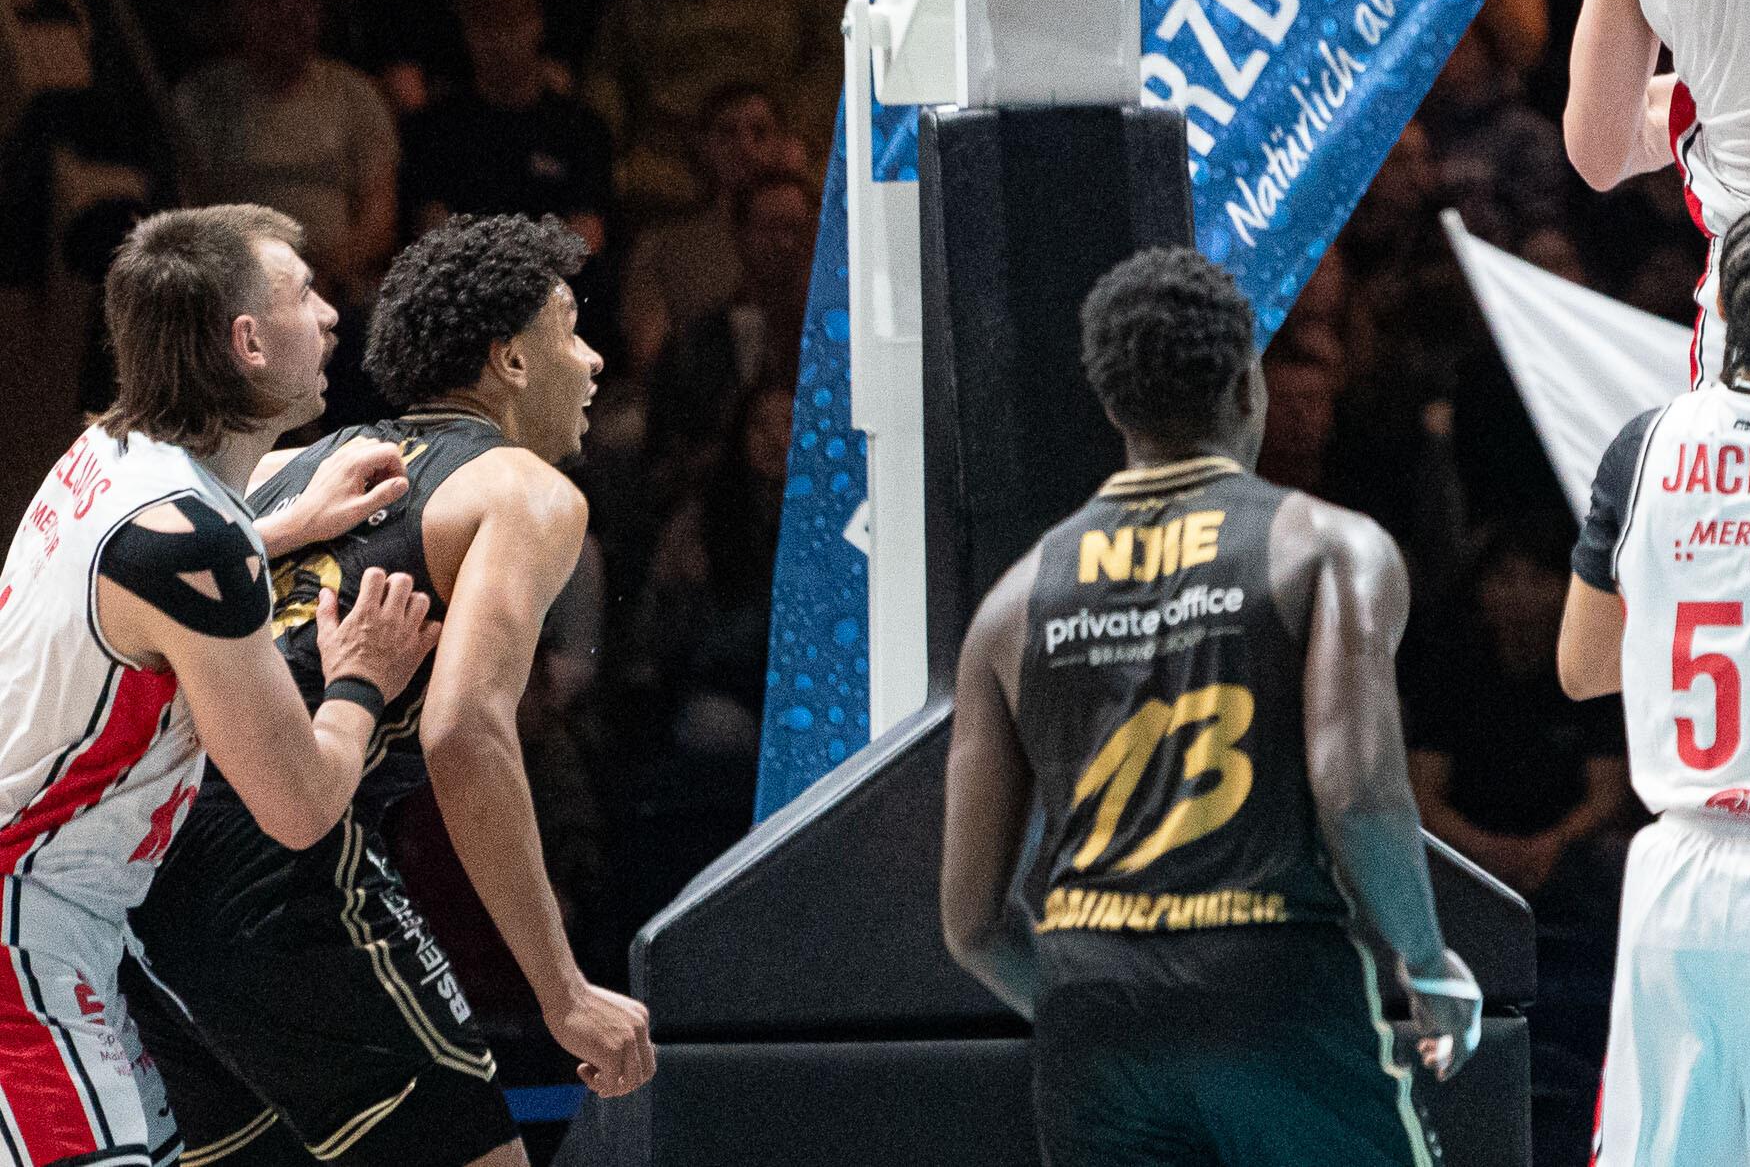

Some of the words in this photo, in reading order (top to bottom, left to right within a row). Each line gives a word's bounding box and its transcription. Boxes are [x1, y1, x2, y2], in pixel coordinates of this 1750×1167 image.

[1224, 40, 1367, 248] Natürlich
[1078, 510, 1226, 584] NJIE
[1046, 608, 1161, 654] private
[1161, 584, 1245, 626] office
[1071, 683, 1256, 872] 13
